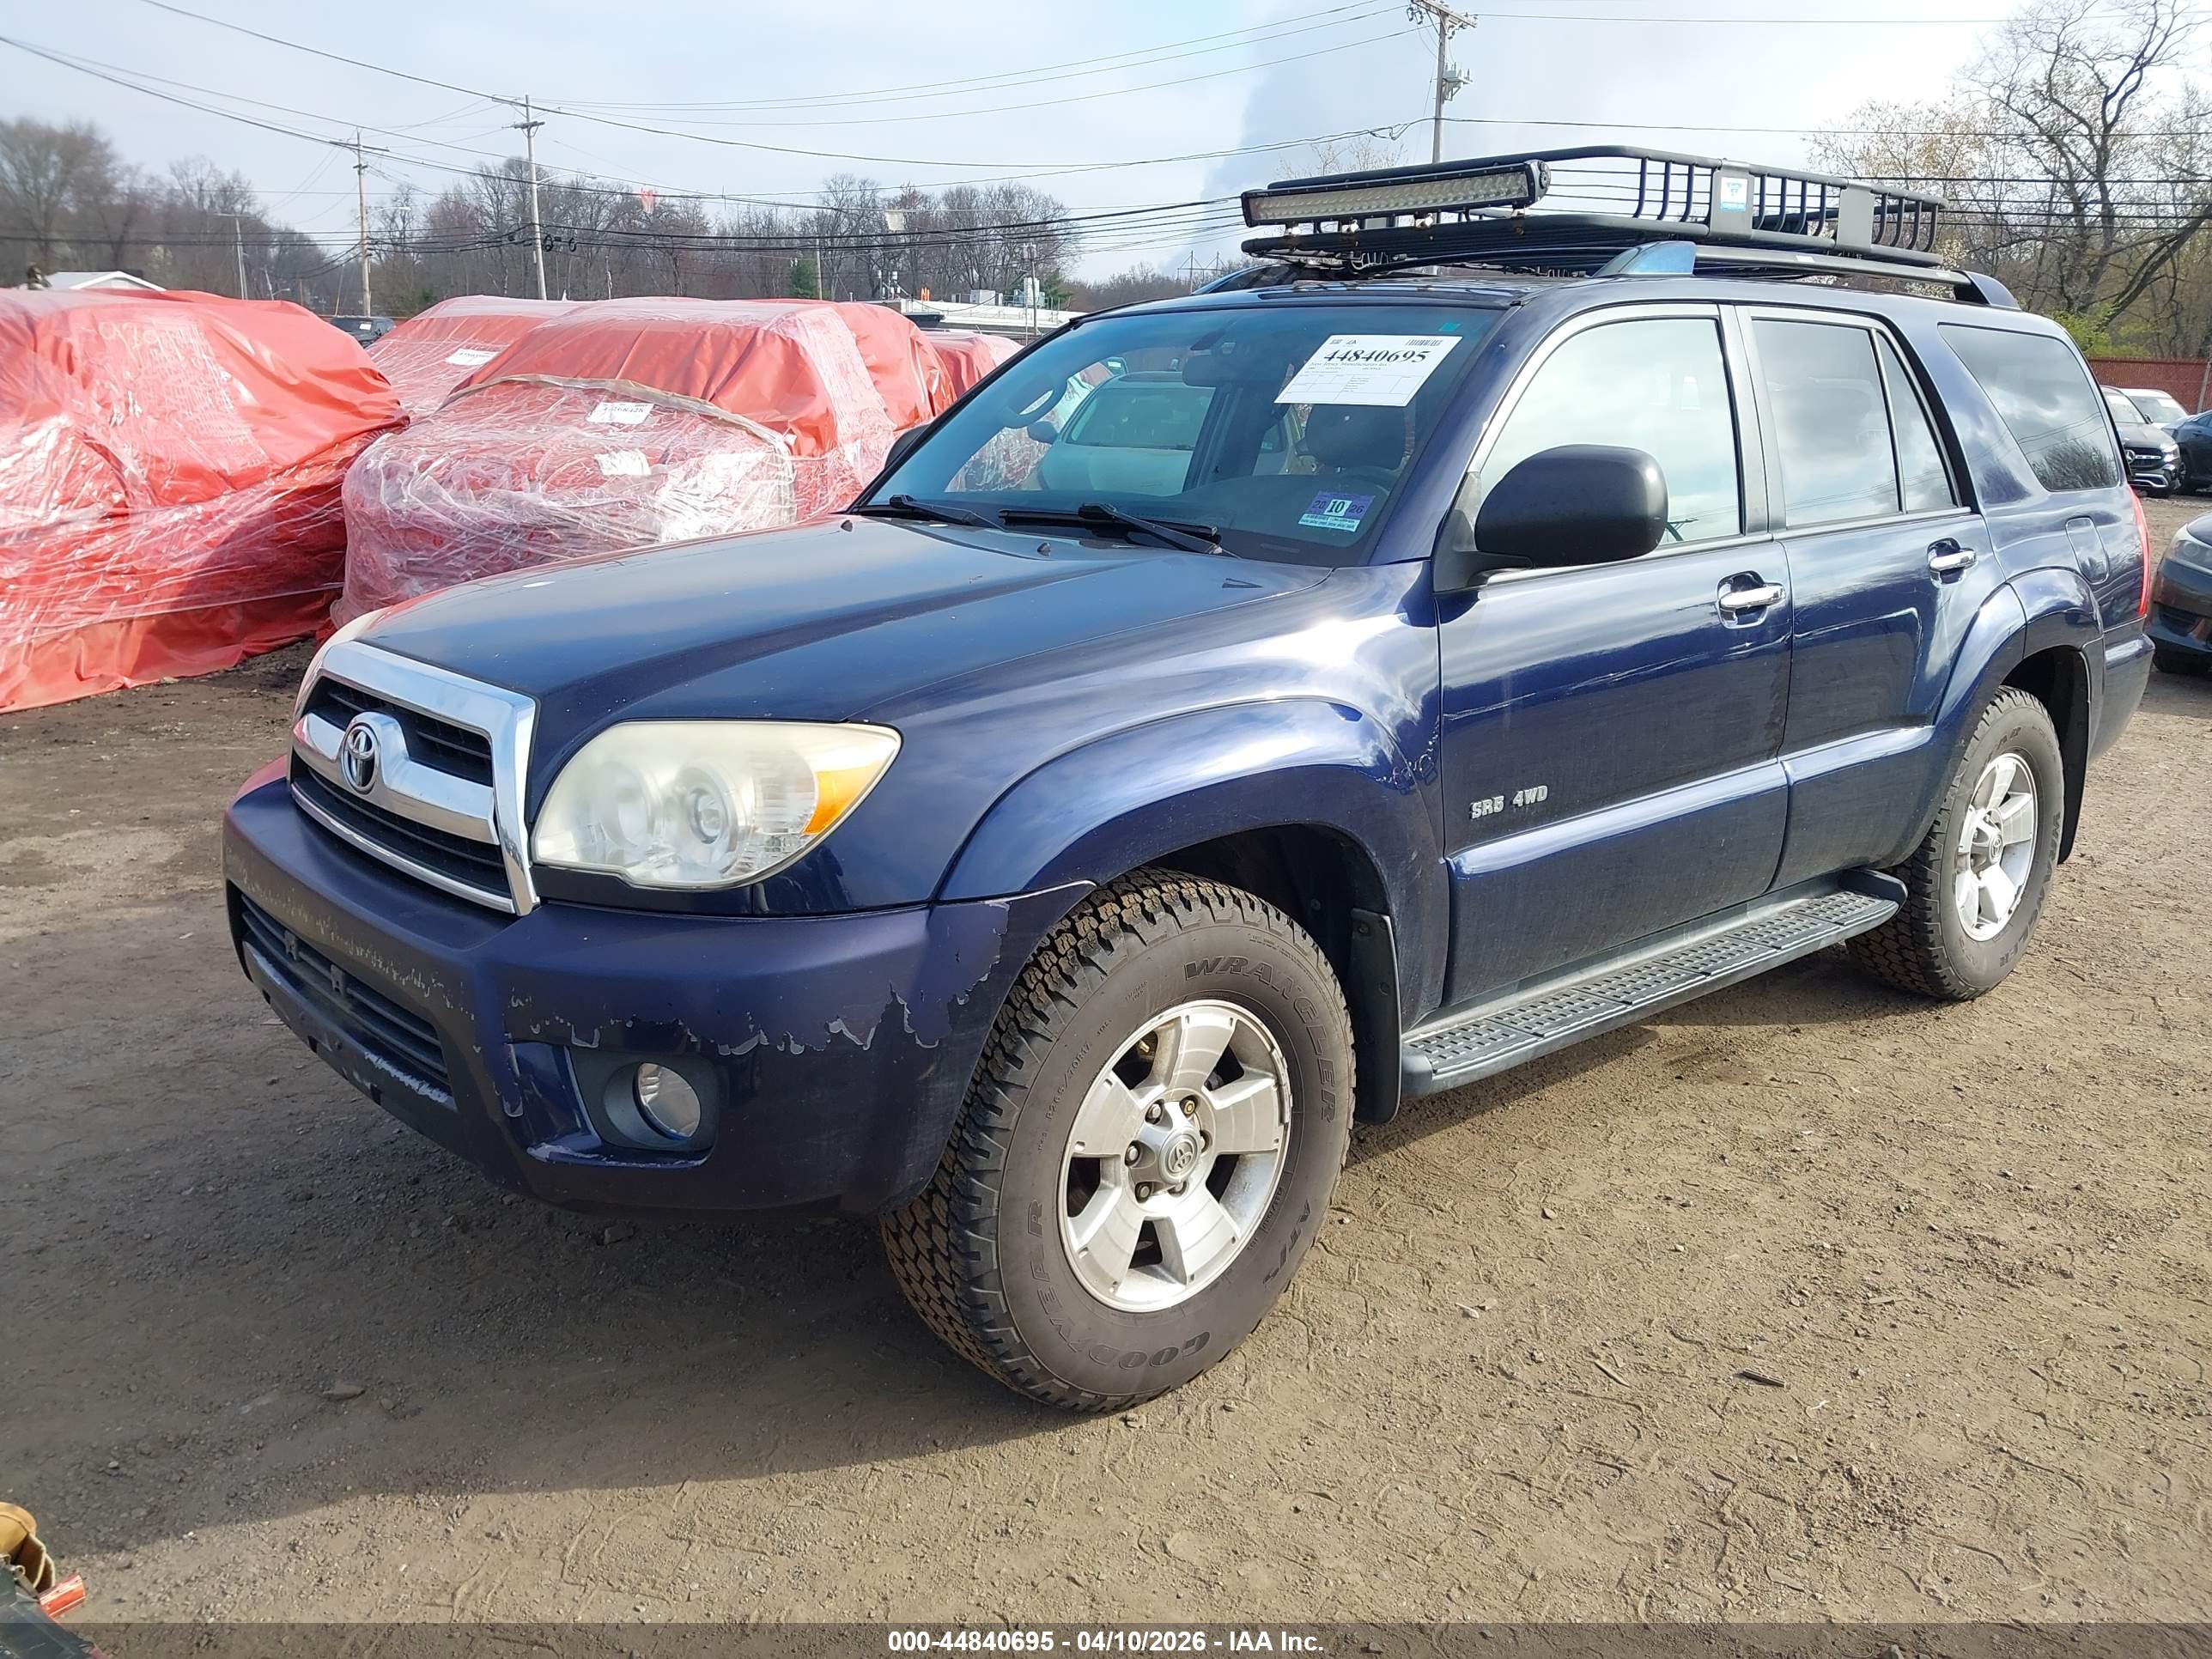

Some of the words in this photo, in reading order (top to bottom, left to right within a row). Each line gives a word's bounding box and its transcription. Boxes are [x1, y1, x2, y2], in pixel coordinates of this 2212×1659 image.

[1323, 349, 1431, 362] 44840695
[1312, 500, 1327, 509] 20
[1327, 500, 1346, 514] 10
[1349, 504, 1364, 514] 26
[1471, 795, 1504, 819] SR5
[1512, 785, 1548, 807] 4WD
[1184, 955, 1336, 1123] WRANGLER
[1027, 1199, 1211, 1370] GOODYEAR
